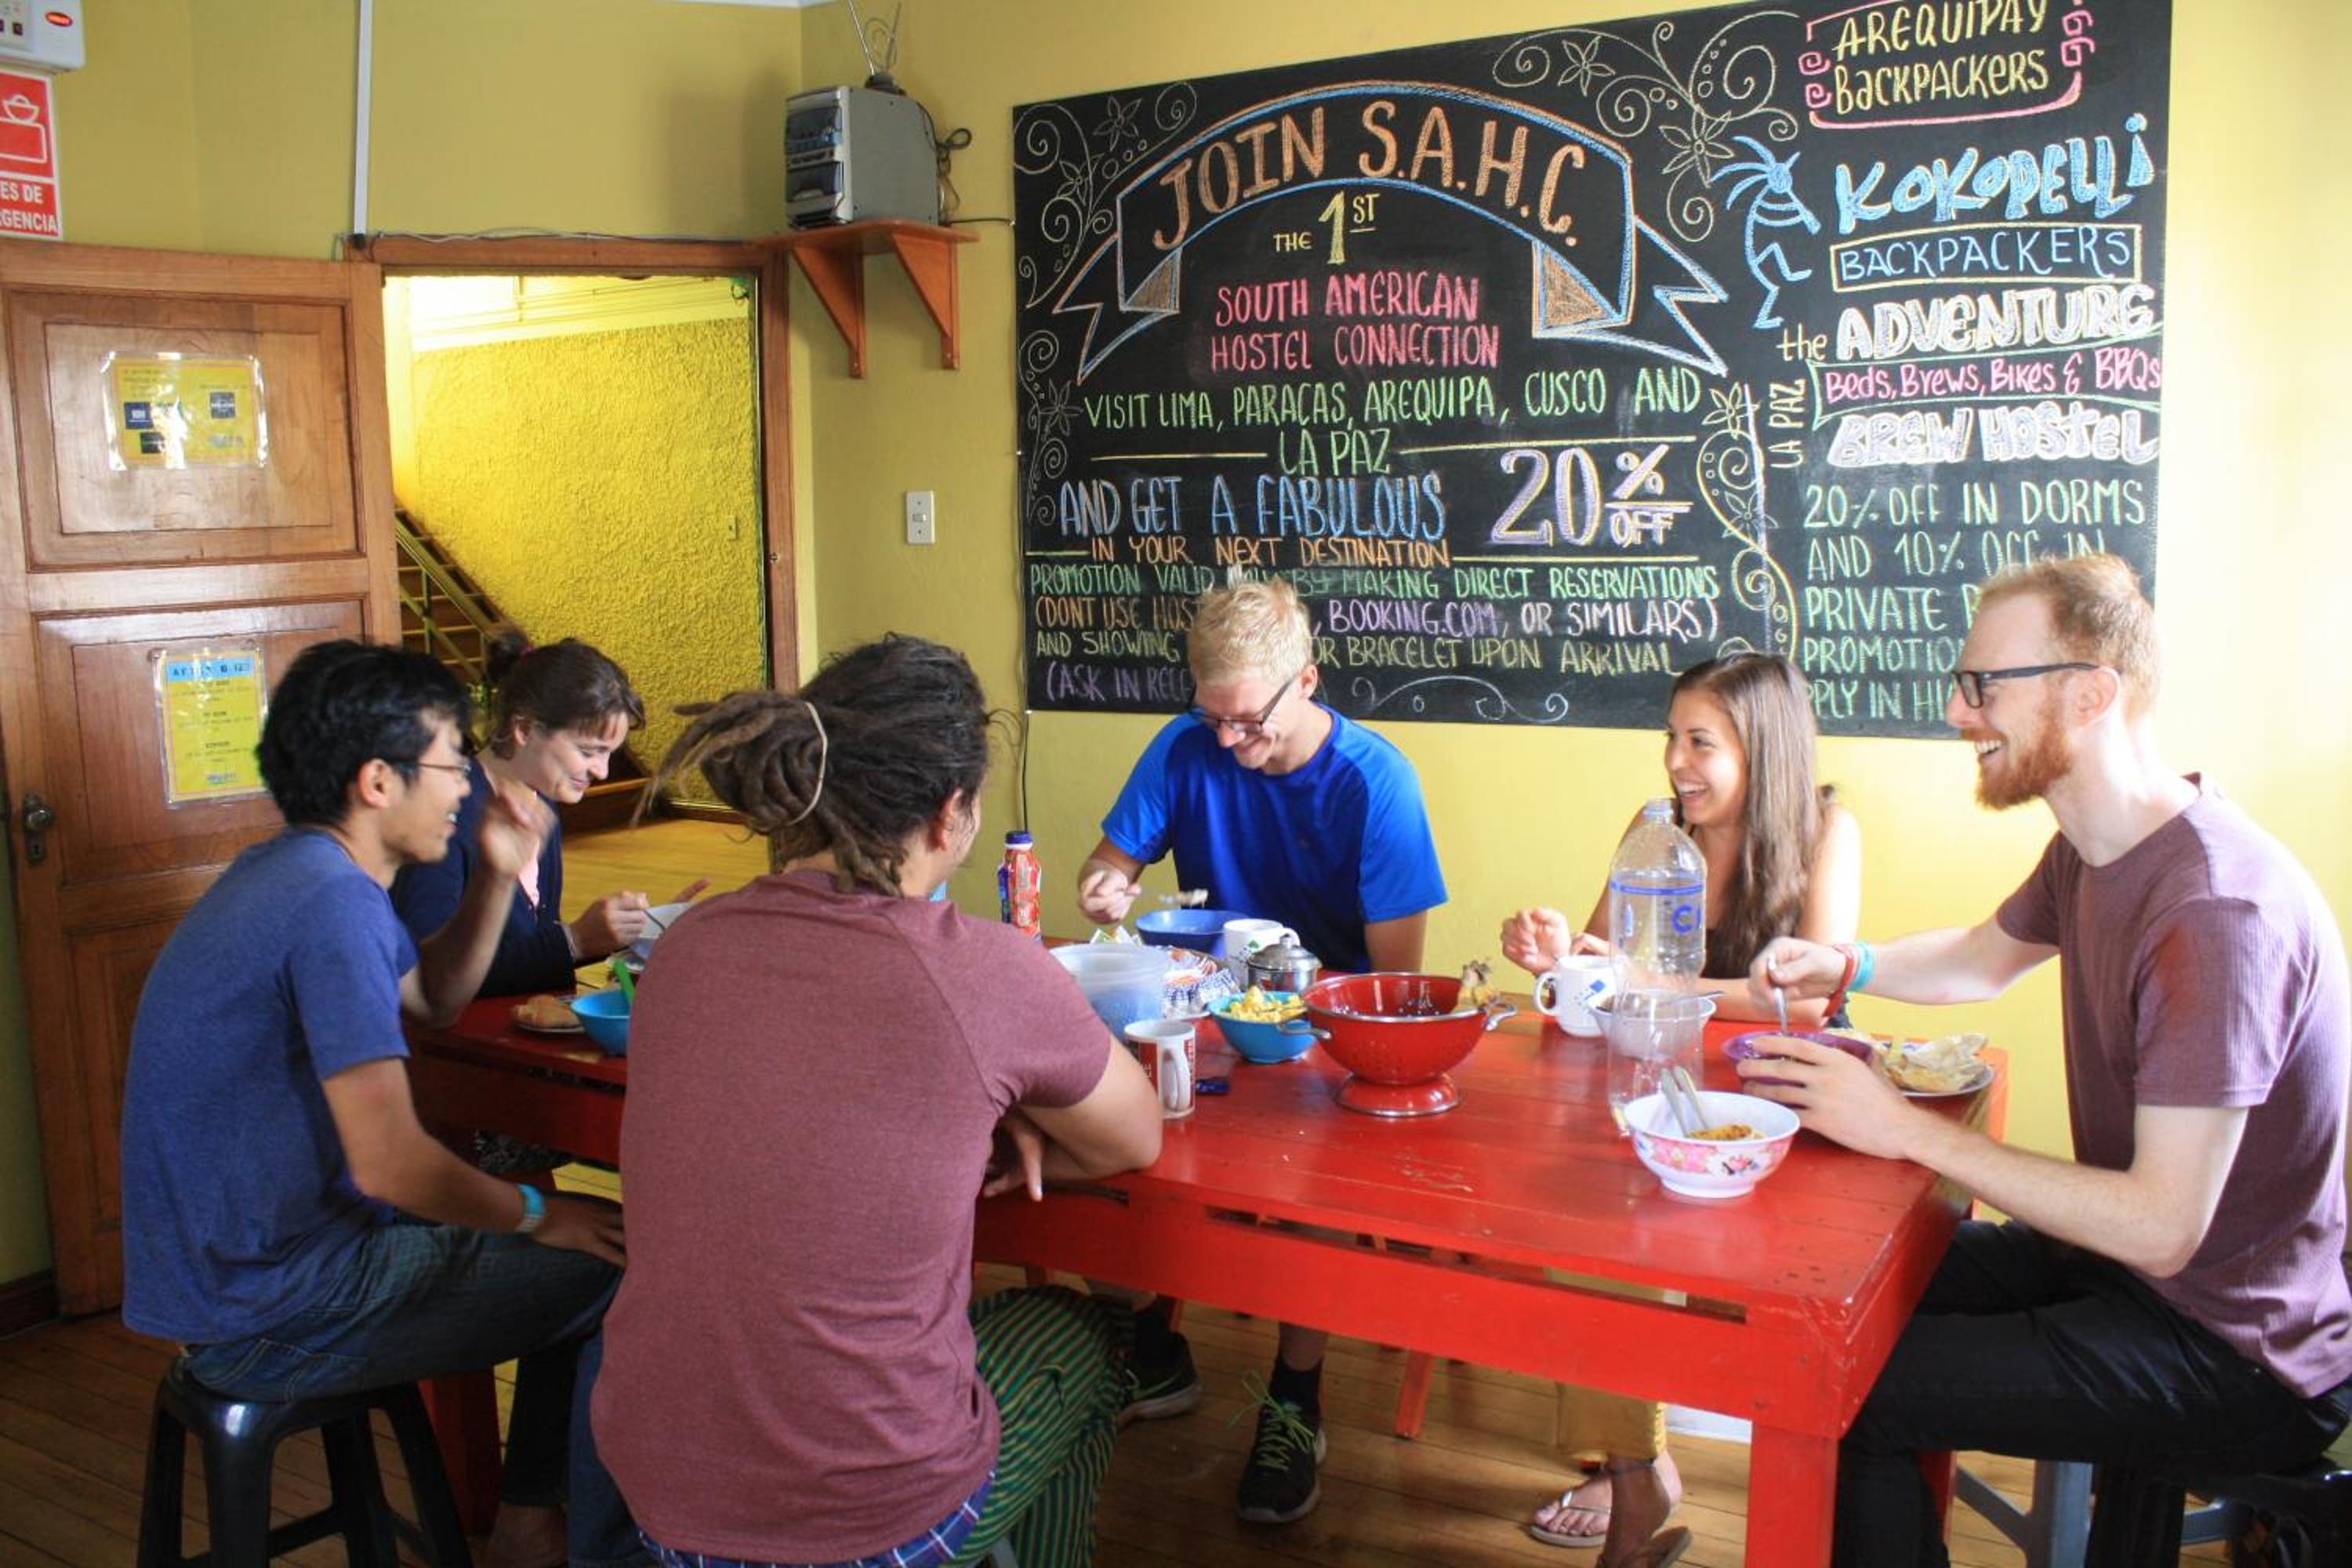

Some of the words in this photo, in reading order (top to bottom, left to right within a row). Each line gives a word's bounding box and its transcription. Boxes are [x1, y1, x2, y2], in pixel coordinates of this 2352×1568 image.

[22, 184, 44, 204] DE
[1152, 106, 1325, 251] JOIN
[1358, 100, 1585, 247] S.A.H.C.
[0, 208, 59, 234] GENCIA
[1272, 231, 1312, 252] THE
[1839, 227, 2130, 281] BACKPACKERS
[1215, 274, 1309, 328] SOUTH
[1324, 270, 1479, 321] AMERICAN
[1776, 323, 1829, 362] the
[1836, 284, 2156, 361] ADVENTURE
[1211, 325, 1313, 372] HOSTEL
[1334, 321, 1499, 368] CONNECTION
[1084, 394, 1151, 430] VISIT
[1159, 390, 1225, 433] LIMA,
[1232, 383, 1355, 430] PARACAS,
[1364, 375, 1511, 426] AREQUIPA,
[1525, 367, 1606, 416] CUSCO
[1634, 364, 1701, 414] AND
[1825, 364, 1897, 404] Beds,
[1900, 364, 1987, 398] Brews,
[1990, 357, 2057, 396] Bikes
[2095, 347, 2161, 392] BBQs
[1768, 378, 1806, 429] PAZ
[1279, 428, 1319, 475] LA
[1330, 427, 1391, 475] PAZ
[1827, 408, 1973, 467] BREW
[1060, 481, 1121, 537] AND
[1130, 475, 1182, 535] GET
[1211, 474, 1239, 535] A
[1256, 469, 1446, 541] FABULOUS
[1888, 483, 1940, 527] OFF
[1963, 482, 1999, 524] IN
[2020, 478, 2146, 525] DORMS
[1092, 539, 1114, 562] IN
[1128, 538, 1194, 566] YOUR
[1214, 537, 1283, 567] NEXT
[1300, 536, 1450, 568] DESTINATION
[1610, 510, 1674, 547] OFF
[1807, 535, 1872, 581] AND
[1893, 530, 1964, 577] 10%
[1030, 564, 1143, 594] PROMOTION
[1154, 564, 1215, 596] VALID
[1342, 569, 1439, 600] MAKING
[1454, 567, 1535, 600] DIRECT
[1549, 564, 1722, 601] RESERVATIONS
[1102, 597, 1143, 629] USE
[1152, 595, 1207, 631] HOST
[1521, 601, 1553, 637] OR
[1806, 586, 1947, 632] PRIVATE
[1036, 635, 1072, 657] AND
[1083, 632, 1181, 663] SHOWING
[1347, 635, 1465, 668] BRACELET
[1472, 639, 1543, 669] UPON
[1559, 640, 1684, 677] ARRIVAL
[1115, 667, 1141, 702] IN
[1806, 677, 1860, 718] PPLY
[1868, 681, 1903, 719] IN
